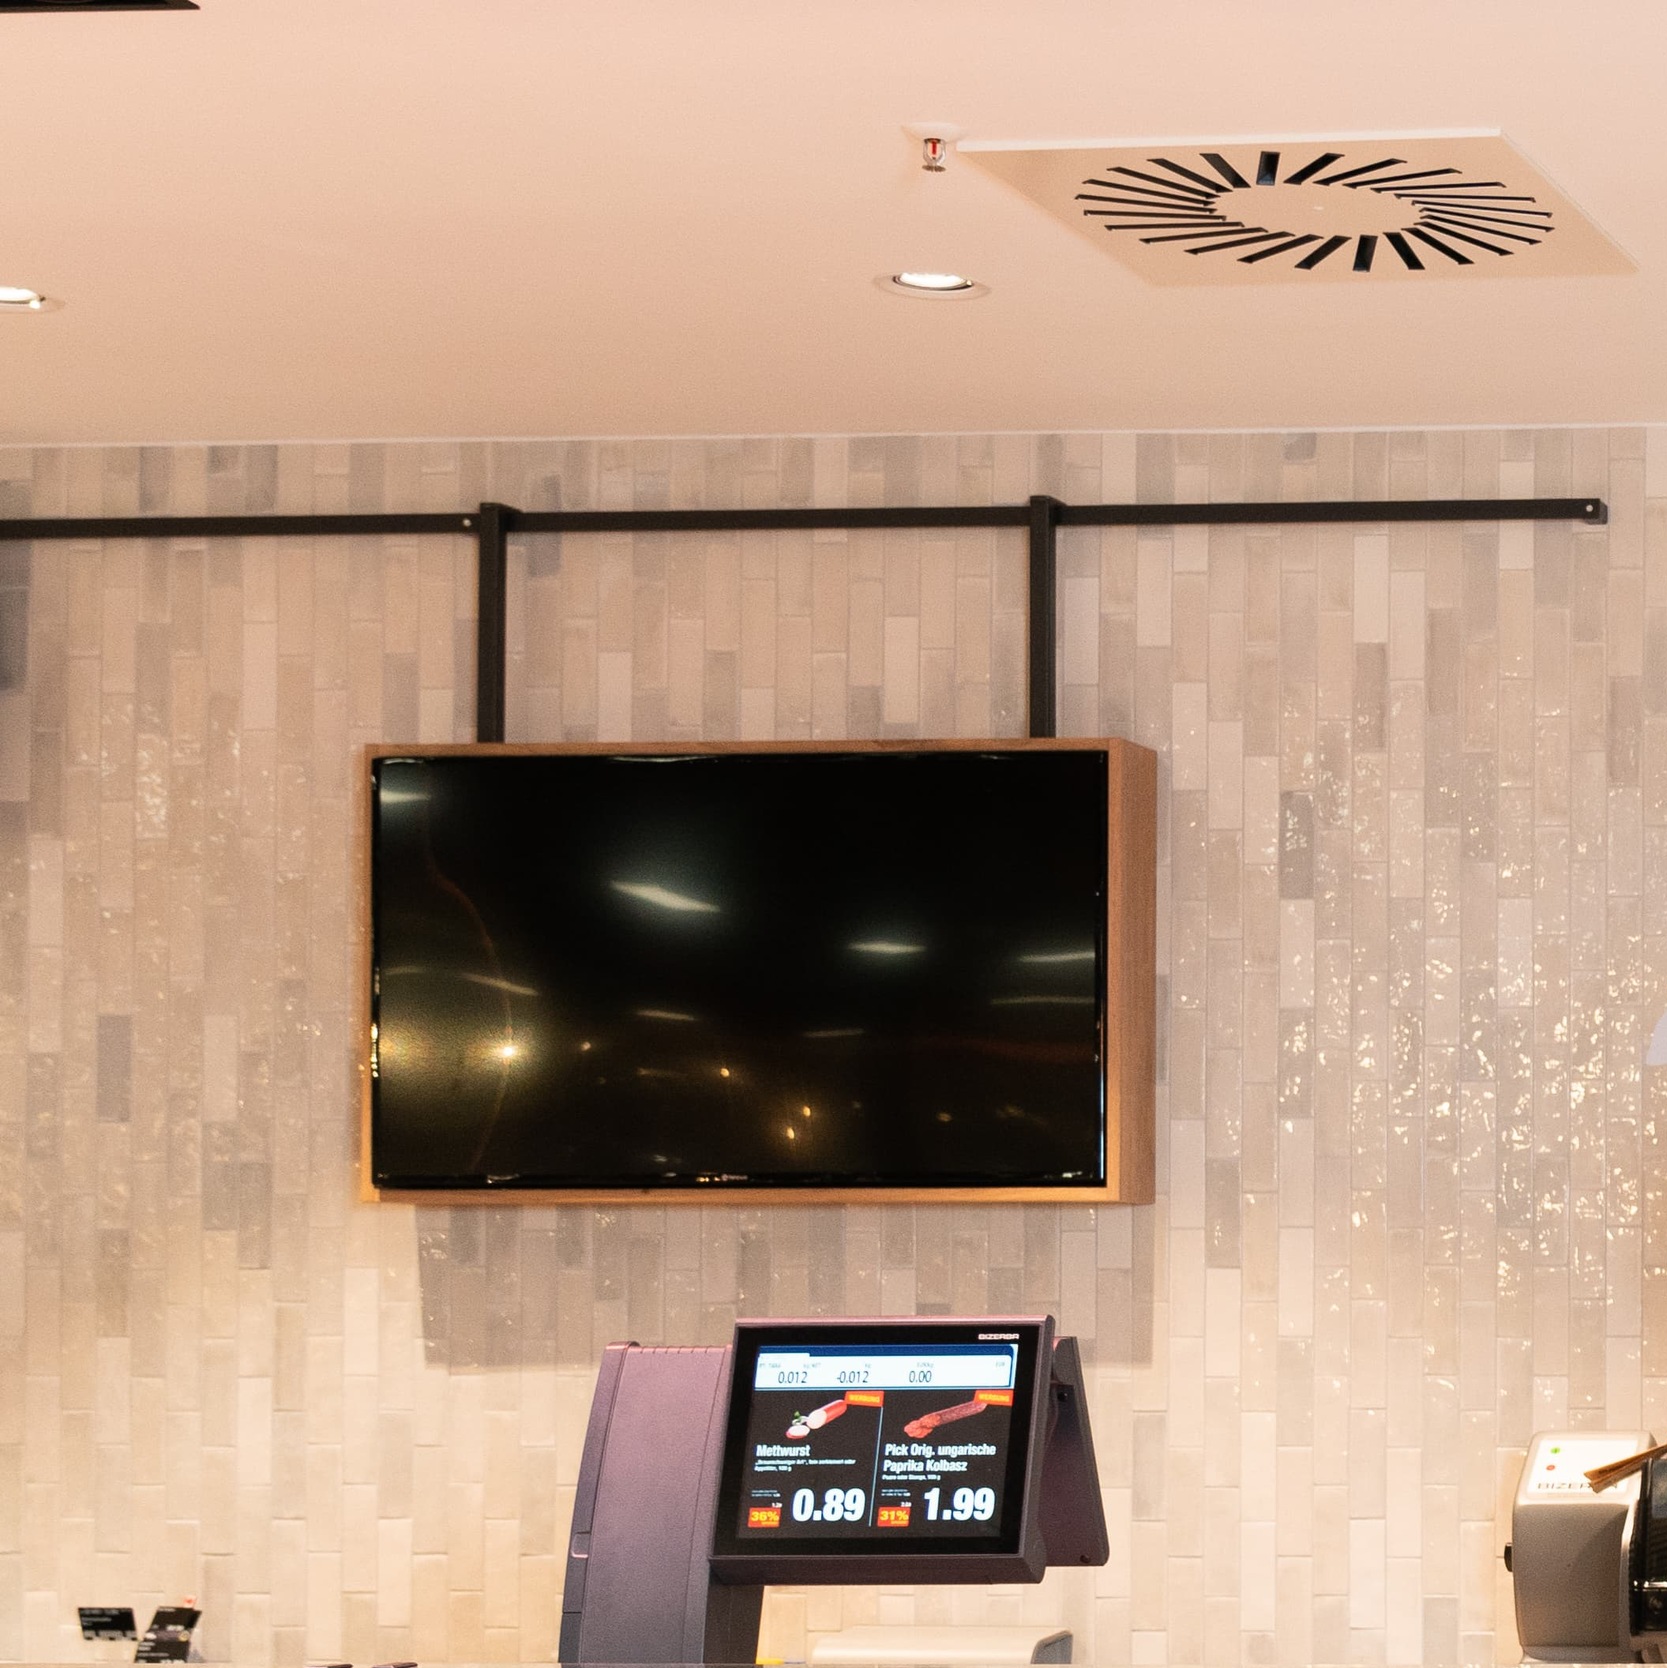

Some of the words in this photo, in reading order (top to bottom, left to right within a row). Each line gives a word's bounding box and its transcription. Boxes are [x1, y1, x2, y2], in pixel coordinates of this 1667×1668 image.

[778, 1371, 808, 1384] 0.012
[836, 1370, 869, 1384] -0.012
[908, 1370, 932, 1384] 0.00
[756, 1444, 810, 1457] Mettwurst
[884, 1443, 908, 1456] Pick
[910, 1444, 935, 1458] Orig.
[937, 1443, 996, 1458] ungarische
[882, 1458, 923, 1474] Paprika
[925, 1458, 967, 1472] Kolbasz
[792, 1488, 866, 1522] 0.89
[923, 1487, 996, 1521] 1.99
[750, 1510, 779, 1523] 36%
[880, 1509, 909, 1522] 31%
